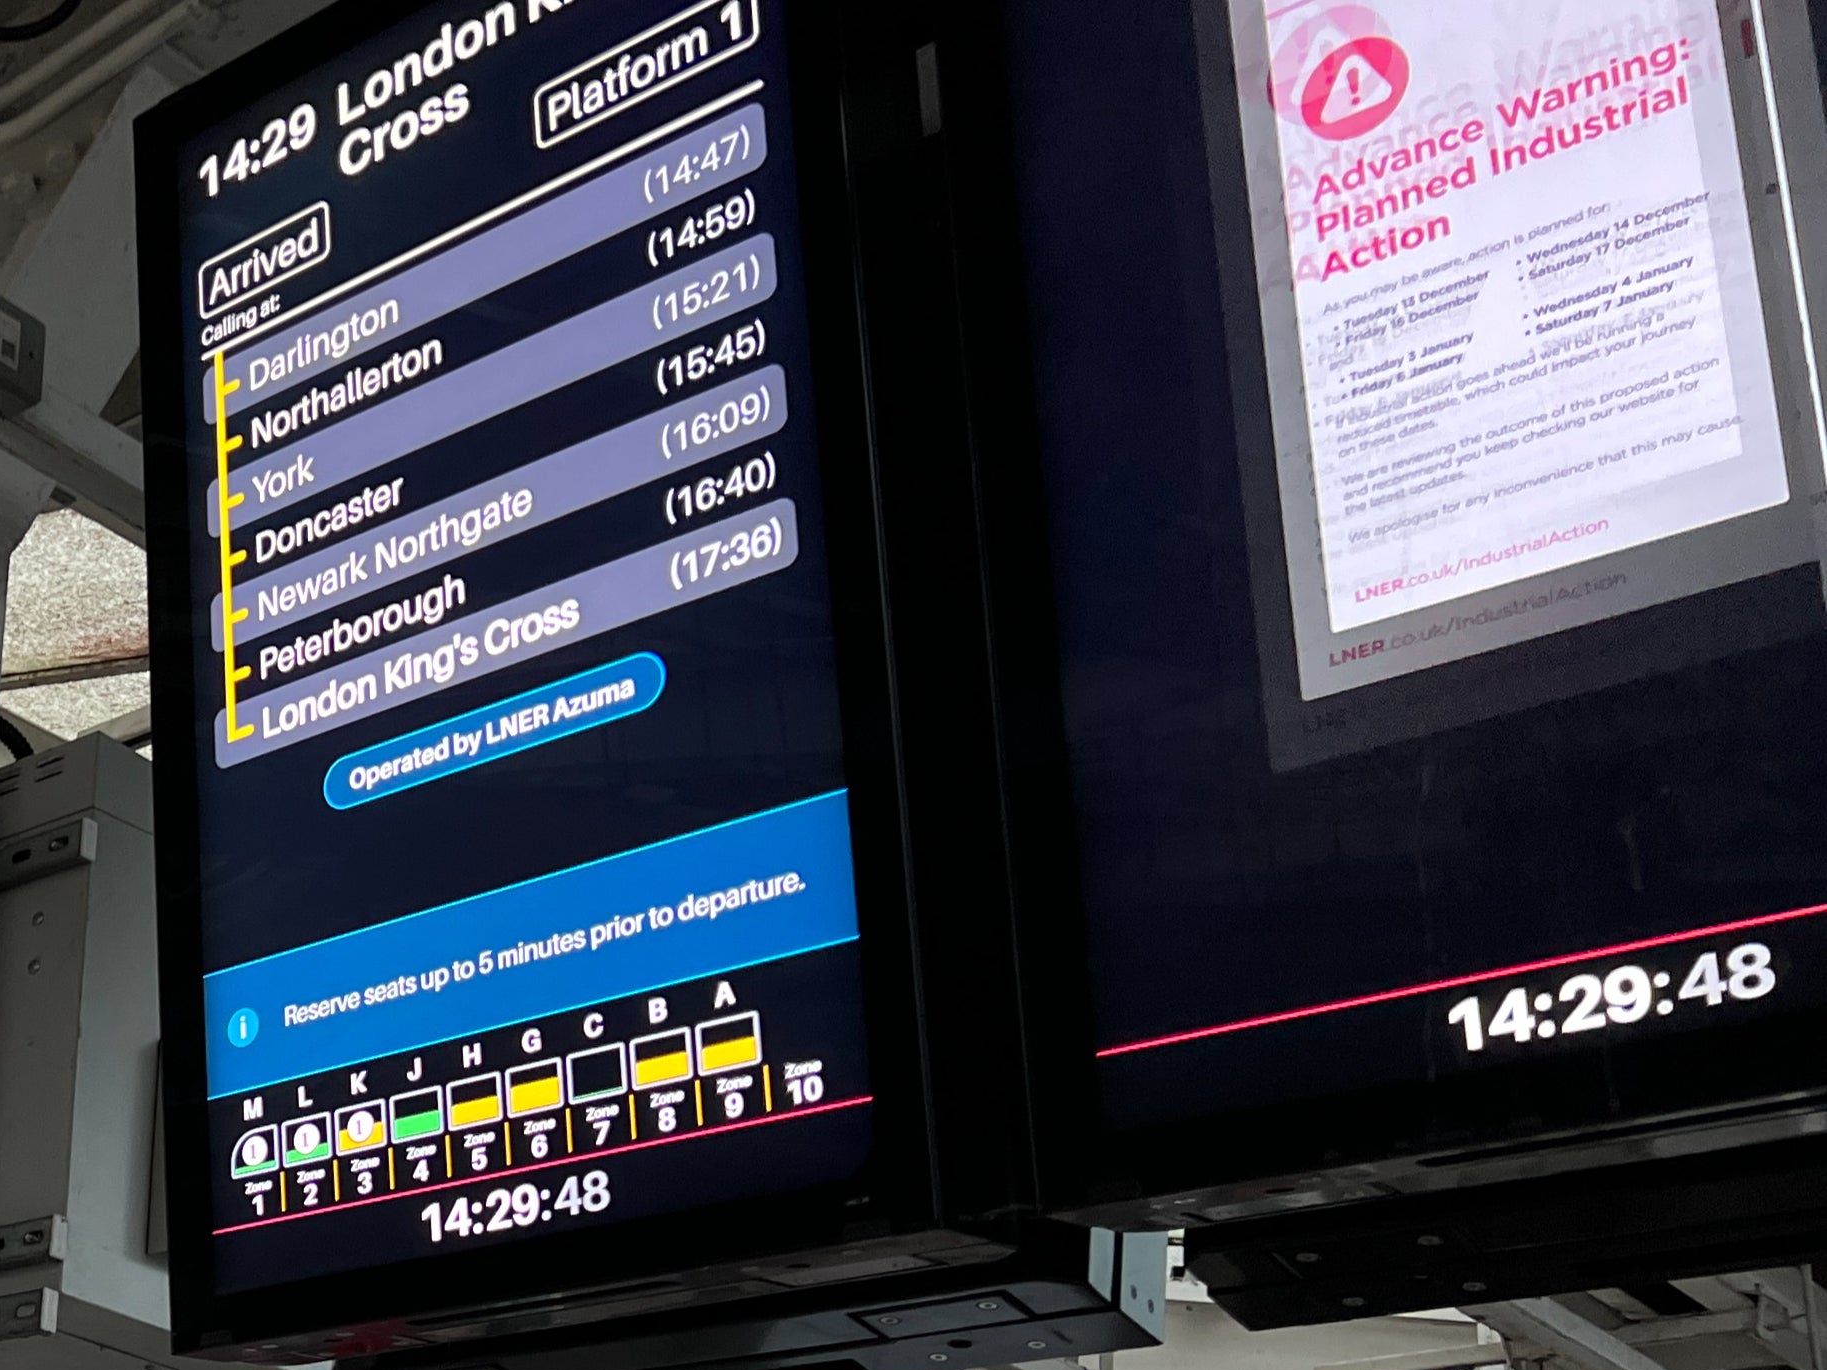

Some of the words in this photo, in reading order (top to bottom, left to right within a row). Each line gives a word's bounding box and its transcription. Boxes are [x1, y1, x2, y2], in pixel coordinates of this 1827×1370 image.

[338, 2, 515, 125] London
[548, 28, 708, 131] Platform
[721, 0, 741, 40] 1
[200, 104, 315, 196] 14:29
[340, 84, 469, 175] Cross
[1313, 121, 1483, 204] Advance
[1497, 38, 1689, 127] Warning:
[645, 125, 749, 203] (14:47)
[1317, 157, 1475, 240] Planned
[1490, 76, 1686, 174] Industrial
[209, 218, 318, 305] Arrived
[649, 189, 754, 266] (14:59)
[1322, 216, 1449, 282] Action
[1401, 273, 1419, 286] be
[1467, 239, 1511, 262] action
[1527, 210, 1584, 241] planned
[1526, 227, 1610, 263] Wednesday
[1613, 218, 1630, 232] 14
[1633, 191, 1710, 226] December
[1528, 251, 1592, 280] Saturday
[1595, 242, 1611, 256] 17
[1614, 216, 1690, 250] December
[202, 306, 262, 345] Calling
[260, 295, 280, 317] at:
[653, 254, 759, 329] (15:21)
[1343, 303, 1398, 330] Tuesday
[1418, 270, 1490, 303] December
[1345, 324, 1388, 347] Friday
[1408, 291, 1479, 324] December
[1533, 281, 1618, 317] Wednesday
[1621, 275, 1632, 287] 4
[1635, 256, 1694, 284] January
[1535, 306, 1600, 335] Saturday
[1603, 299, 1612, 312] 7
[1616, 280, 1674, 308] January
[250, 300, 398, 391] Darlington
[657, 319, 764, 394] (15:45)
[1348, 356, 1405, 381] Tuesday
[1420, 332, 1474, 358] January
[1351, 377, 1393, 398] Friday
[1409, 353, 1463, 379] January
[1455, 371, 1490, 391] goes
[1492, 352, 1537, 377] ahead
[1597, 312, 1656, 342] running
[1464, 380, 1506, 401] which
[1508, 364, 1548, 386] could
[1551, 347, 1601, 373] impact
[1604, 336, 1637, 357] your
[1641, 316, 1696, 345] journey
[252, 340, 441, 448] Northallerton
[662, 386, 769, 459] (16:09)
[1391, 442, 1457, 471] reviewing
[1459, 434, 1482, 448] the
[1485, 413, 1549, 440] outcome
[1551, 404, 1566, 418] of
[1569, 398, 1596, 413] this
[1599, 371, 1670, 405] proposed
[1673, 357, 1720, 380] action
[1455, 450, 1482, 468] you
[1484, 438, 1519, 456] keep
[1521, 416, 1586, 444] checking
[1589, 407, 1614, 422] our
[1617, 388, 1676, 413] website
[1678, 379, 1700, 393] for
[252, 455, 314, 502] York
[666, 452, 775, 524] (16:40)
[1373, 509, 1439, 537] apologise
[1441, 501, 1461, 514] for
[1465, 492, 1490, 508] any
[1493, 461, 1594, 498] inconvenience
[1597, 449, 1627, 466] that
[1630, 440, 1658, 456] this
[1661, 430, 1693, 447] may
[256, 478, 403, 563] Doncaster
[259, 552, 367, 620] Newark
[375, 490, 532, 573] Northgate
[671, 517, 781, 590] (17:36)
[1355, 520, 1608, 602] LNER.co.uk/IndustrialAction
[260, 576, 465, 679] Peterborough
[263, 674, 376, 738] London
[385, 633, 478, 694] King's
[484, 600, 579, 655] Cross
[350, 737, 449, 790] Operated
[453, 730, 482, 755] by
[486, 704, 549, 744] LNER
[553, 679, 634, 722] Azuma
[285, 992, 360, 1026] Reserve
[364, 976, 417, 1005] seats
[421, 968, 449, 991] up
[452, 961, 475, 981] to
[479, 951, 493, 974] 5
[498, 931, 586, 969] minutes
[591, 914, 645, 950] prior
[648, 907, 673, 929] to
[678, 873, 805, 921] departure.
[1449, 944, 1775, 1050] 14:29:48
[243, 1097, 263, 1121] M
[298, 1086, 313, 1108] L
[350, 1071, 368, 1095] K
[407, 1057, 422, 1081] J
[462, 1043, 482, 1068] H
[521, 1028, 542, 1053] G
[583, 1012, 604, 1038] C
[648, 998, 668, 1024] B
[714, 981, 736, 1009] A
[716, 1076, 753, 1094] Zone
[784, 1060, 823, 1079] Zone
[524, 1119, 556, 1134] Zone
[585, 1104, 620, 1121] Zone
[650, 1090, 685, 1107] Zone
[657, 1106, 677, 1132] 8
[724, 1092, 743, 1118] 9
[786, 1076, 823, 1106] 10
[351, 1156, 380, 1172] Zone
[406, 1144, 437, 1160] Zone
[463, 1131, 495, 1147] Zone
[472, 1147, 487, 1170] 5
[531, 1134, 548, 1158] 6
[593, 1120, 611, 1146] 7
[245, 1180, 272, 1195] Zone
[252, 1195, 264, 1215] 1
[297, 1169, 326, 1183] Zone
[303, 1183, 318, 1206] 2
[357, 1172, 373, 1195] 3
[412, 1159, 429, 1181] 4
[422, 1171, 610, 1241] 14:29:48
